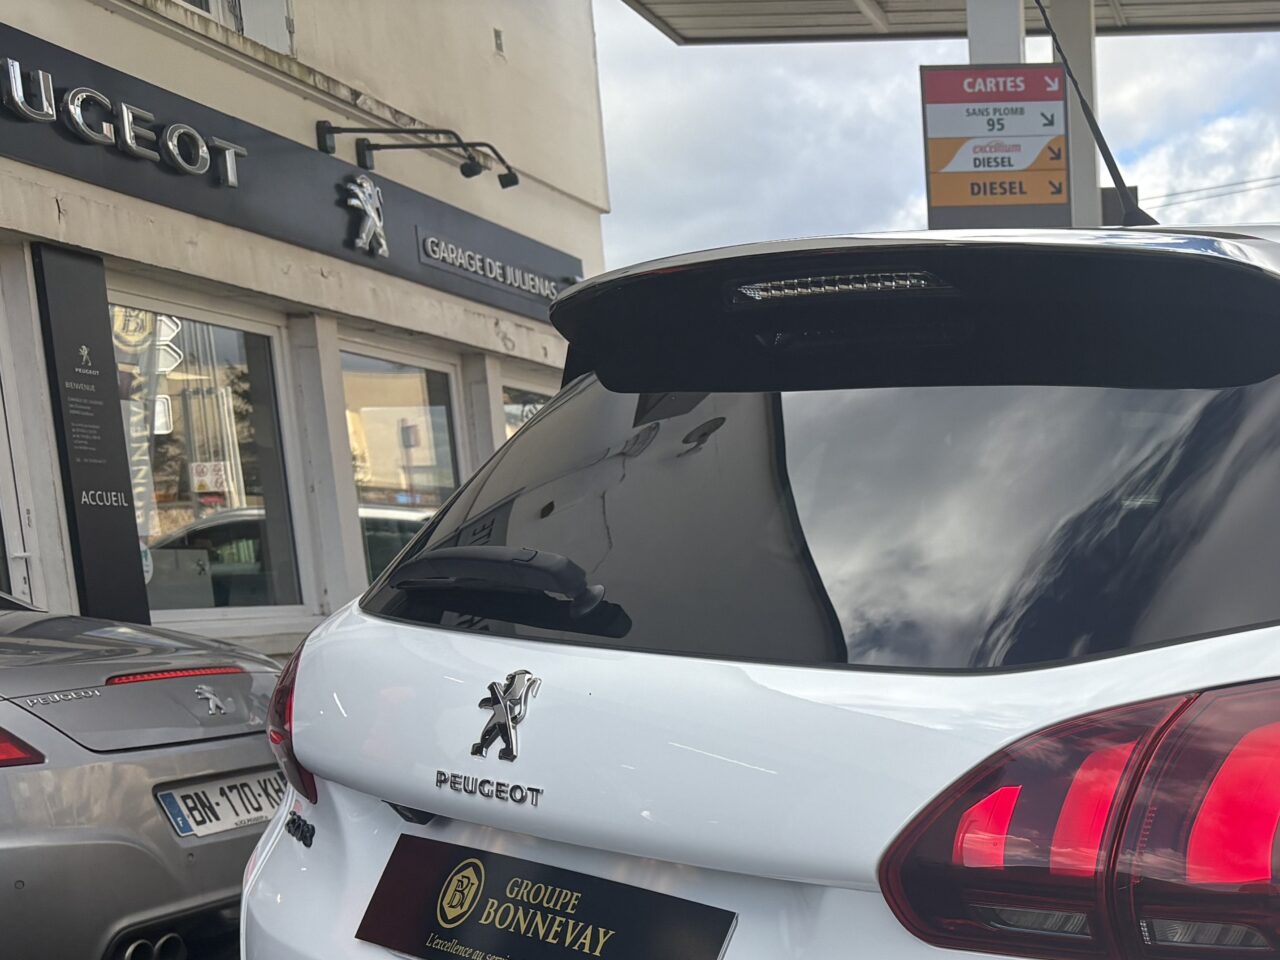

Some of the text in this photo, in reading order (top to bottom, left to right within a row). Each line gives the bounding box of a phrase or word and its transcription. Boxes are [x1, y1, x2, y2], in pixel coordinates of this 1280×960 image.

[963, 77, 1025, 93] CARTES
[965, 106, 1025, 117] SANS PLOMB
[6, 57, 248, 188] UGEOT
[986, 118, 1005, 132] 95
[973, 157, 1014, 168] DIESEL
[970, 181, 1027, 197] DIESEL
[426, 237, 558, 300] GARAGE DE JULIENAS
[81, 490, 128, 507] ACCUEIL
[26, 689, 101, 708] PEUGEOT
[435, 770, 544, 807] PEUGEOT
[505, 877, 582, 914] GROUPE
[478, 898, 616, 957] BONNEVAY
[426, 932, 472, 957] L'excellence
